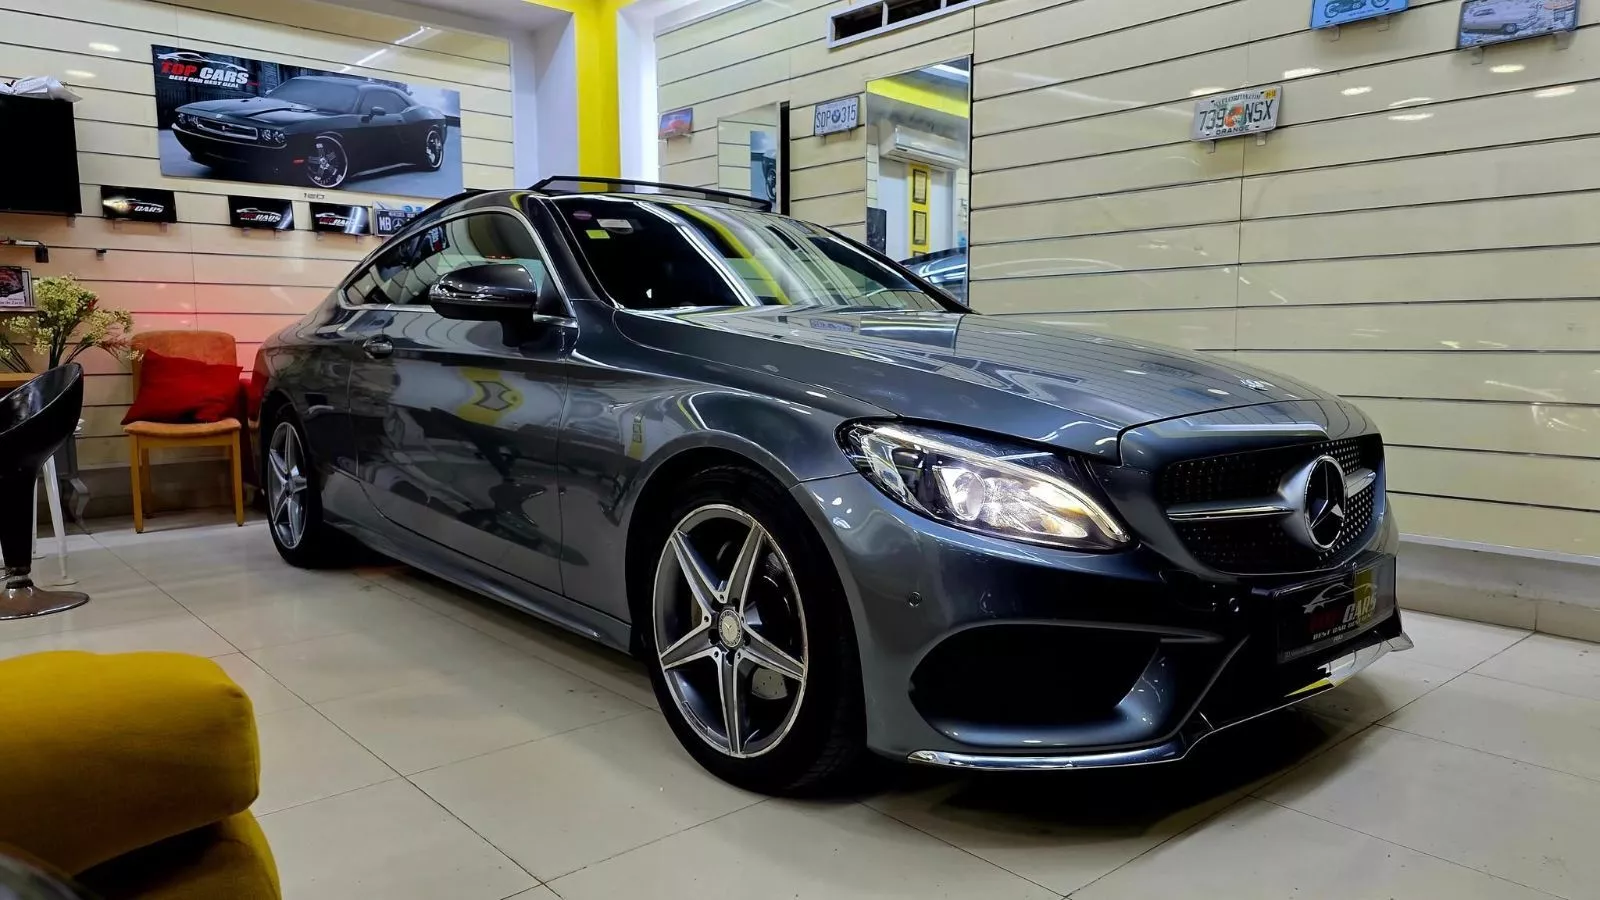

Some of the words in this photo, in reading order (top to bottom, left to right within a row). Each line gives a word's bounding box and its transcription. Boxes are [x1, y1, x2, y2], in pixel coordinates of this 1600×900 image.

[161, 61, 197, 76] TOP
[199, 67, 249, 84] CARS
[816, 110, 832, 129] SDP
[841, 104, 857, 123] 315
[1199, 107, 1226, 131] 739
[1244, 99, 1274, 123] NSX
[1215, 125, 1250, 136] ORANGE
[134, 205, 164, 213] CARS
[256, 214, 281, 222] CARS
[379, 216, 391, 231] MB
[1342, 593, 1377, 623] CARS
